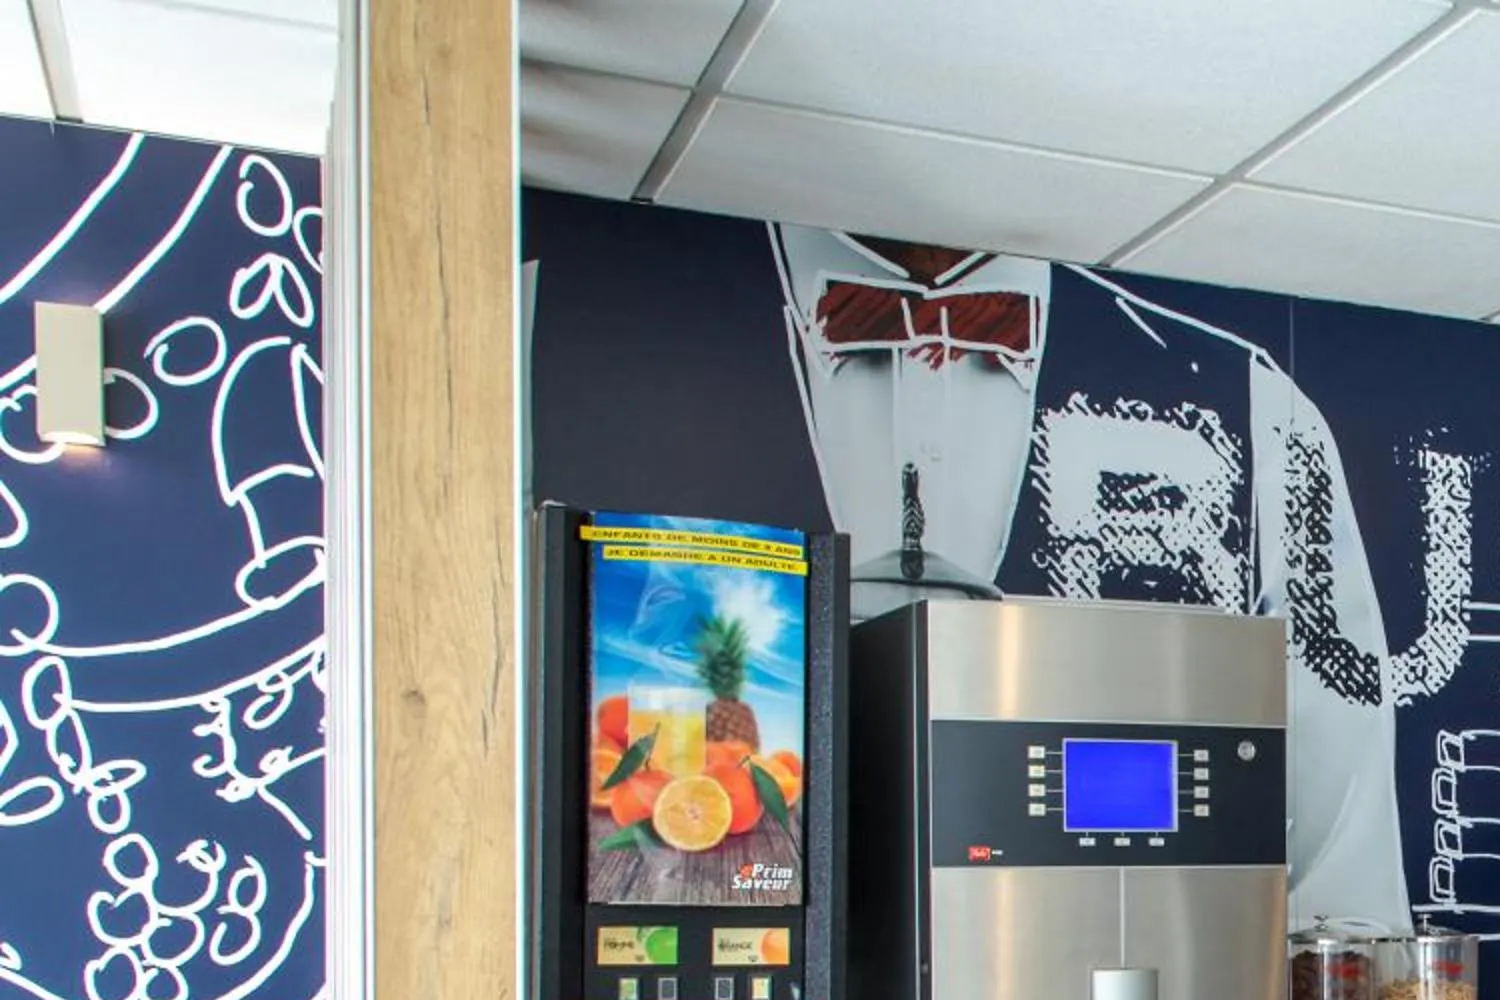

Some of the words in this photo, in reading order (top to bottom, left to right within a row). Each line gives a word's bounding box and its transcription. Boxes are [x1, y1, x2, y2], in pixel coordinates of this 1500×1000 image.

[691, 534, 738, 549] MOINS
[752, 863, 793, 878] Prim
[731, 874, 791, 891] Saveur
